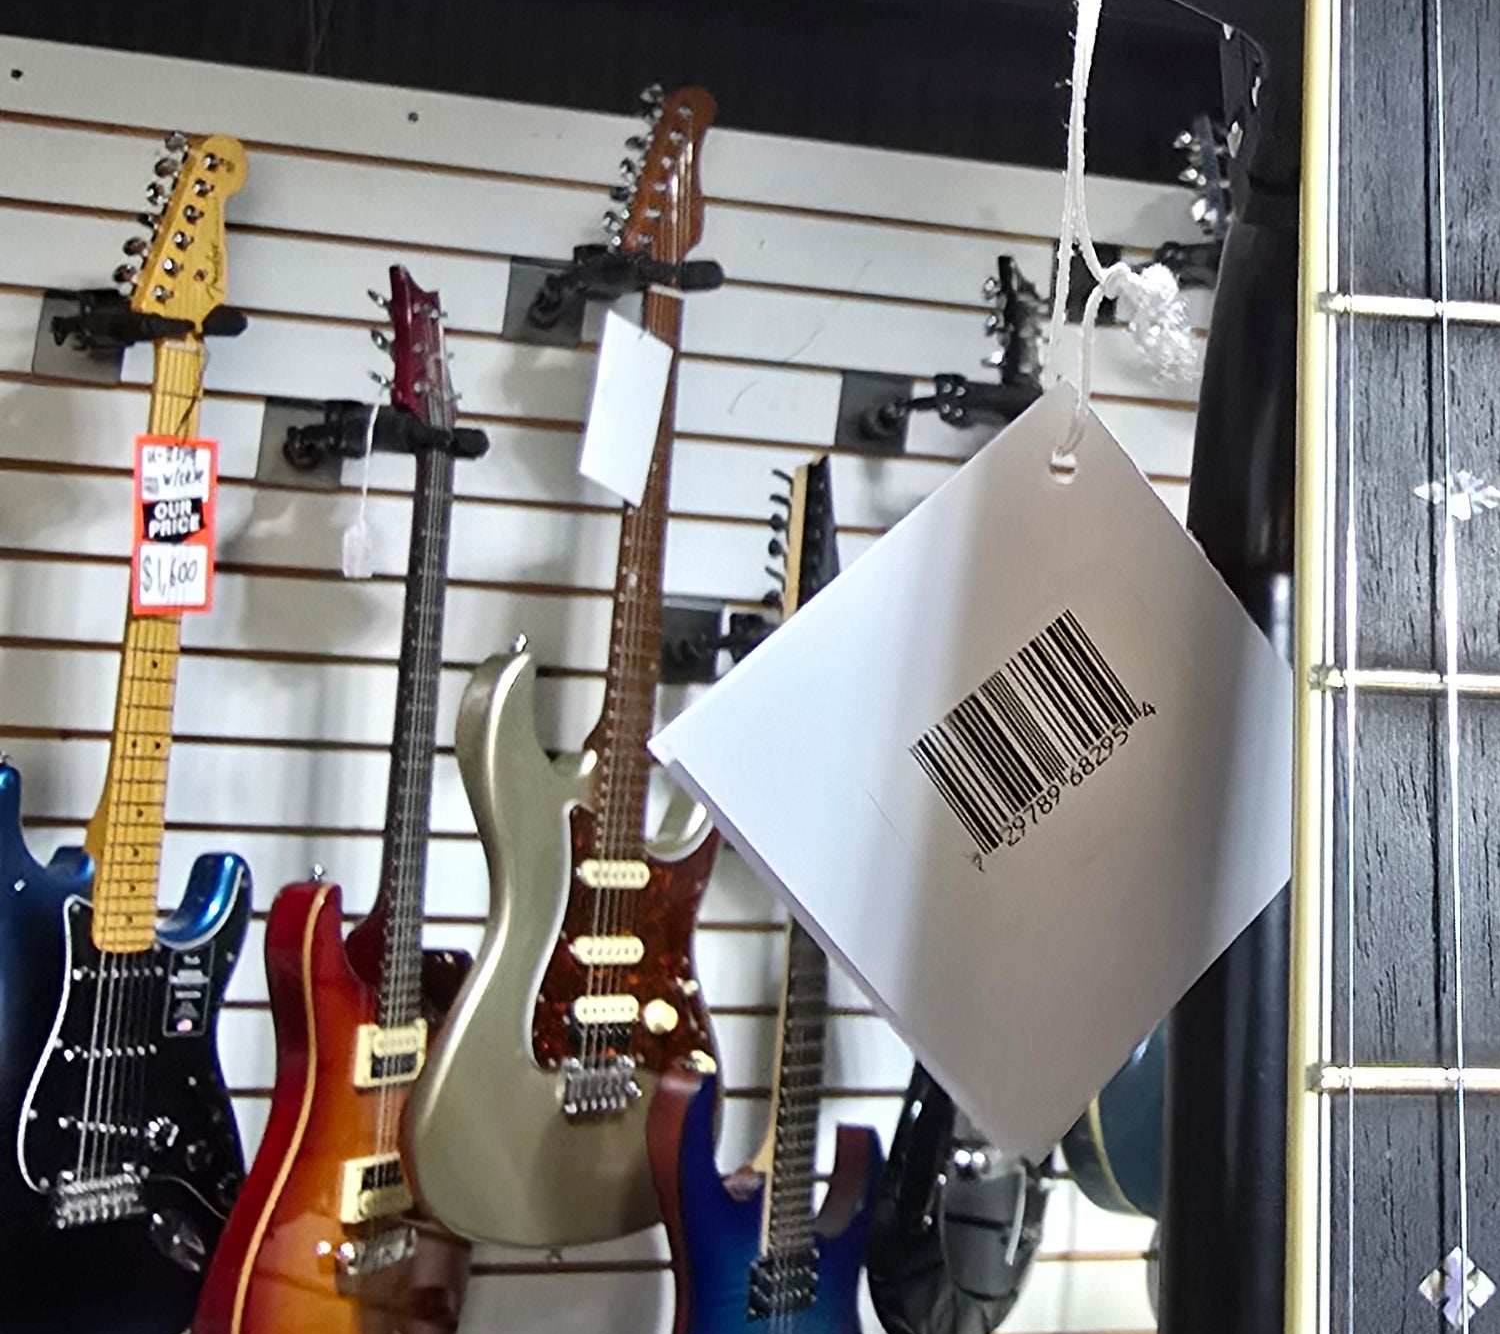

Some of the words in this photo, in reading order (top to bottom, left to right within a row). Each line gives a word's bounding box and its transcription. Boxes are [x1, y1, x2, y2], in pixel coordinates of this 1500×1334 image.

[148, 514, 201, 539] PRICE
[153, 499, 193, 521] OUR
[141, 555, 199, 597] $1,600
[1002, 784, 1061, 847] 29789
[1069, 723, 1129, 787] 68295
[1141, 700, 1158, 718] 4
